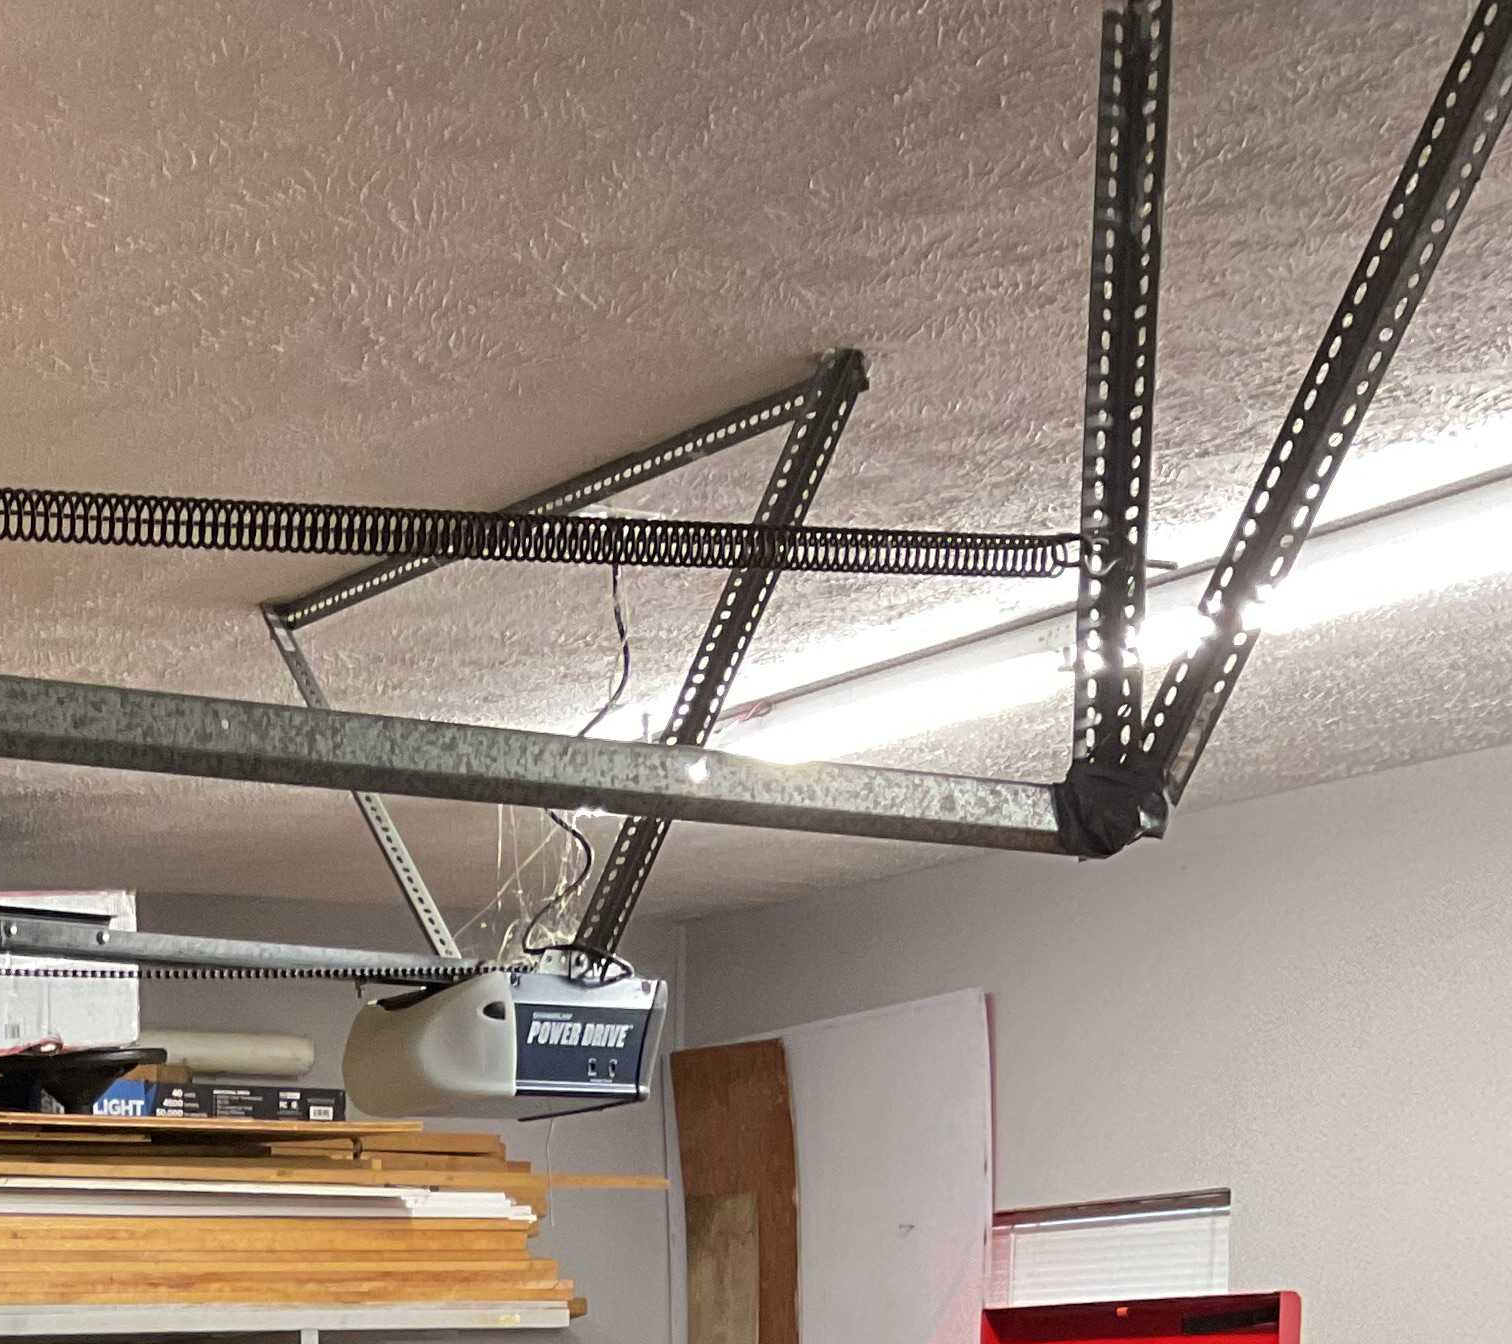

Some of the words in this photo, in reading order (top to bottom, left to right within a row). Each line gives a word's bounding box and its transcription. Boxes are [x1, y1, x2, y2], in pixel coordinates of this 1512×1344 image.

[527, 1020, 582, 1046] POWER
[581, 1023, 627, 1048] DRIVE
[93, 1099, 145, 1116] LIGHT
